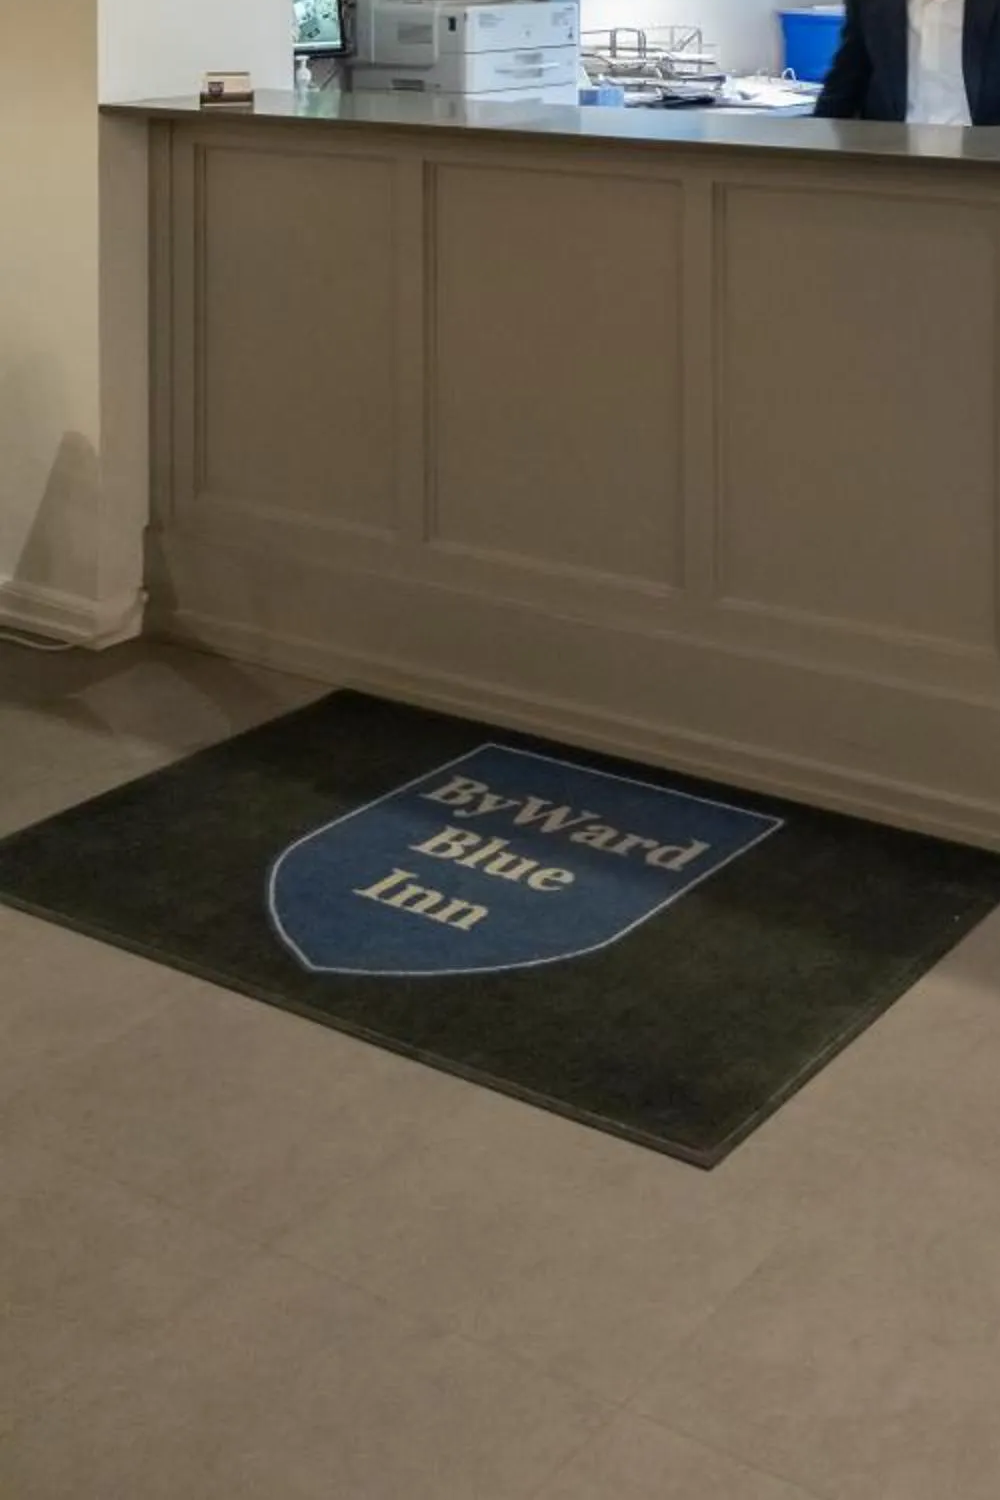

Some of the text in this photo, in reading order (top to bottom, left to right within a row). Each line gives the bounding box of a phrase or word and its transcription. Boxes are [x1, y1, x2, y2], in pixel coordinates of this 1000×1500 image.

[421, 775, 711, 871] ByWard
[409, 825, 575, 891] Blue
[353, 868, 489, 931] Inn
